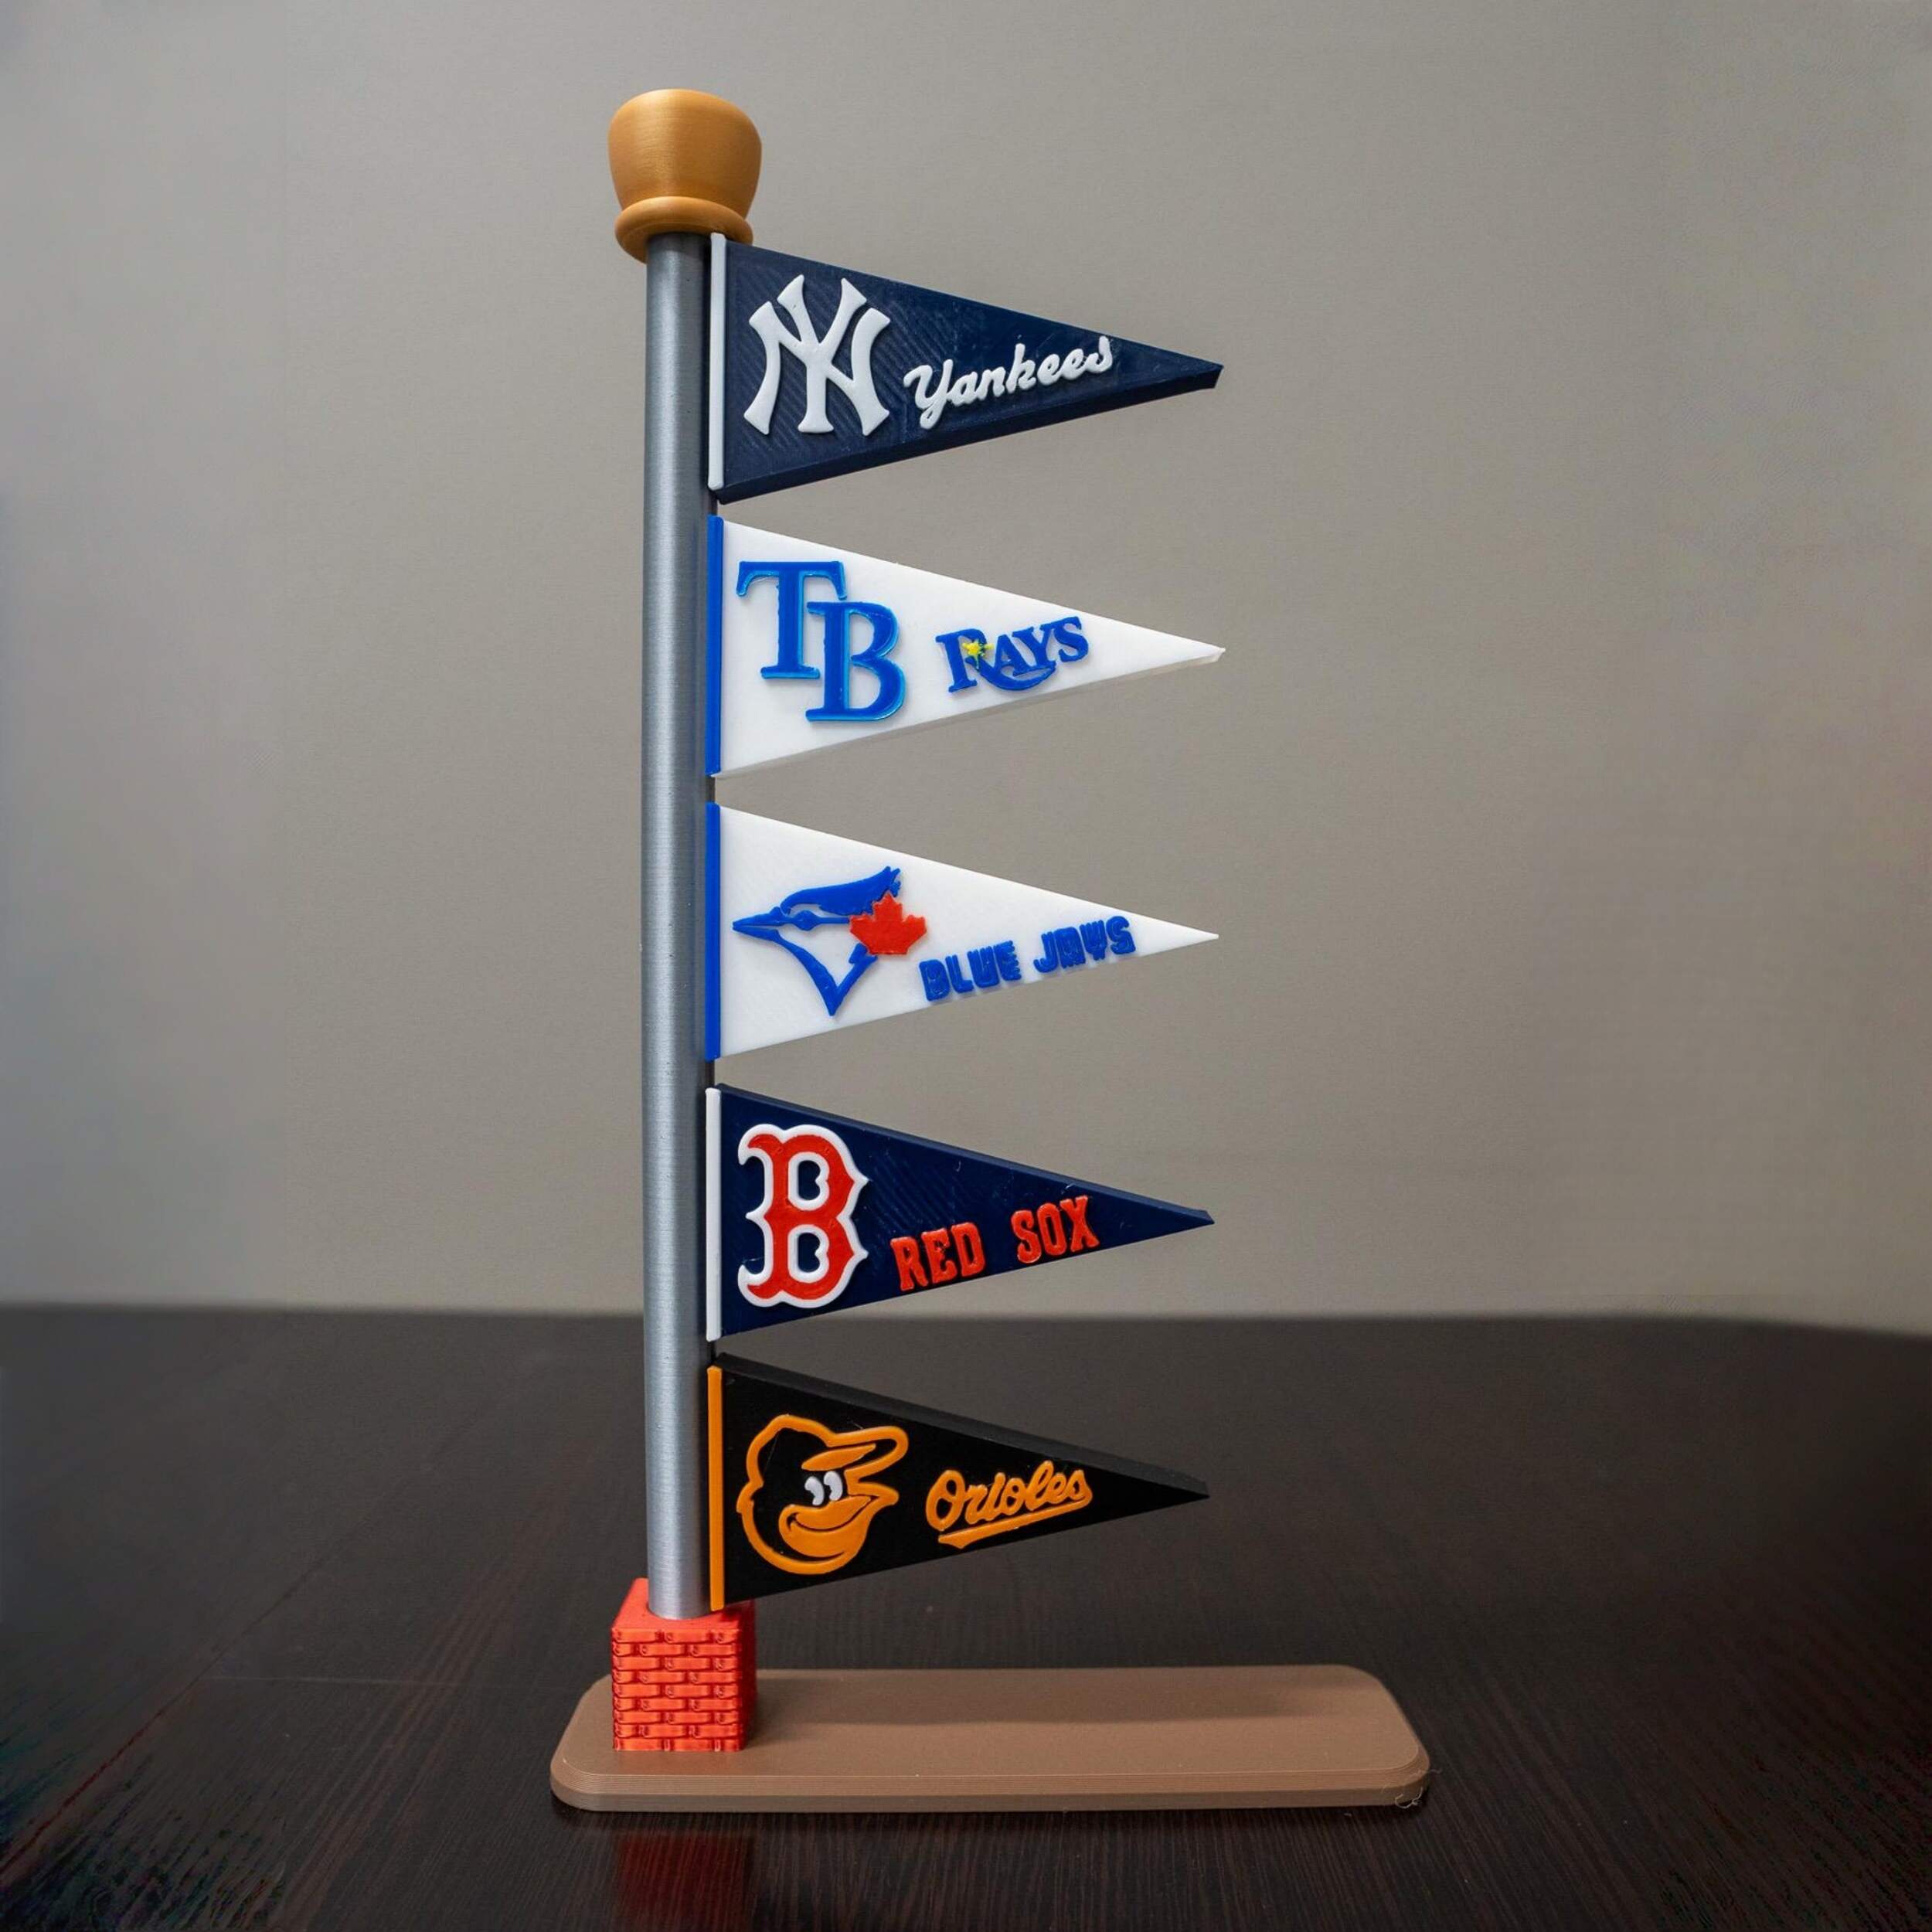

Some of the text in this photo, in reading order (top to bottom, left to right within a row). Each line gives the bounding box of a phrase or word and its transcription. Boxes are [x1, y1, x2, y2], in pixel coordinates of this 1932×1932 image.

[743, 274, 890, 436] NY
[903, 336, 1113, 429] Yankees
[736, 561, 906, 722] TB
[935, 617, 1089, 693] RAYS
[919, 916, 1136, 1002] BLUE JAYS
[738, 1124, 869, 1308] B
[889, 1195, 1100, 1291] RED SOX
[927, 1460, 1093, 1549] Orioles
